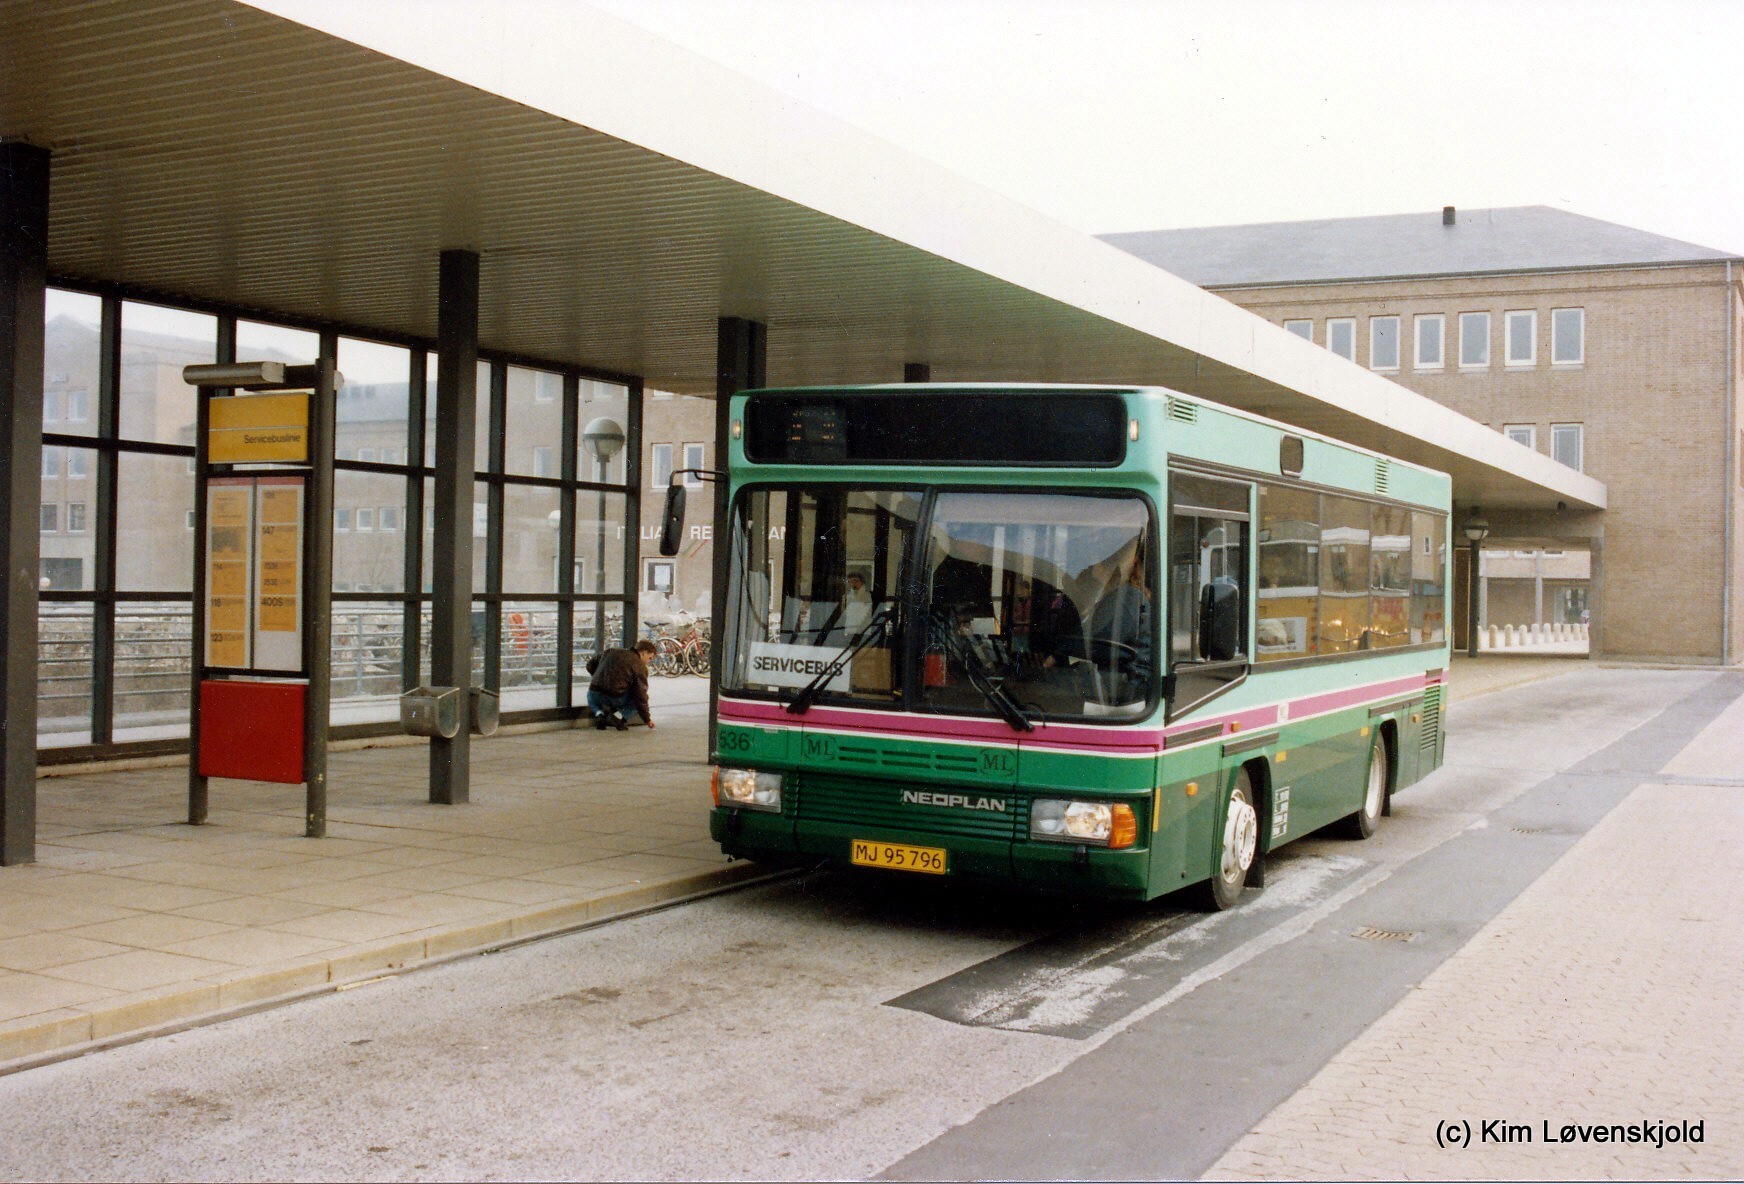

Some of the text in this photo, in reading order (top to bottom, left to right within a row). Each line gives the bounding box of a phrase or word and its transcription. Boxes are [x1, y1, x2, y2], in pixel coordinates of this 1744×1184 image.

[244, 433, 301, 444] Servicebuslinie
[261, 597, 284, 607] 400S
[753, 656, 844, 677] SERVICEBUS
[719, 730, 751, 752] 536
[903, 790, 1006, 812] NEOPLAN
[856, 844, 942, 869] MJ 95 796
